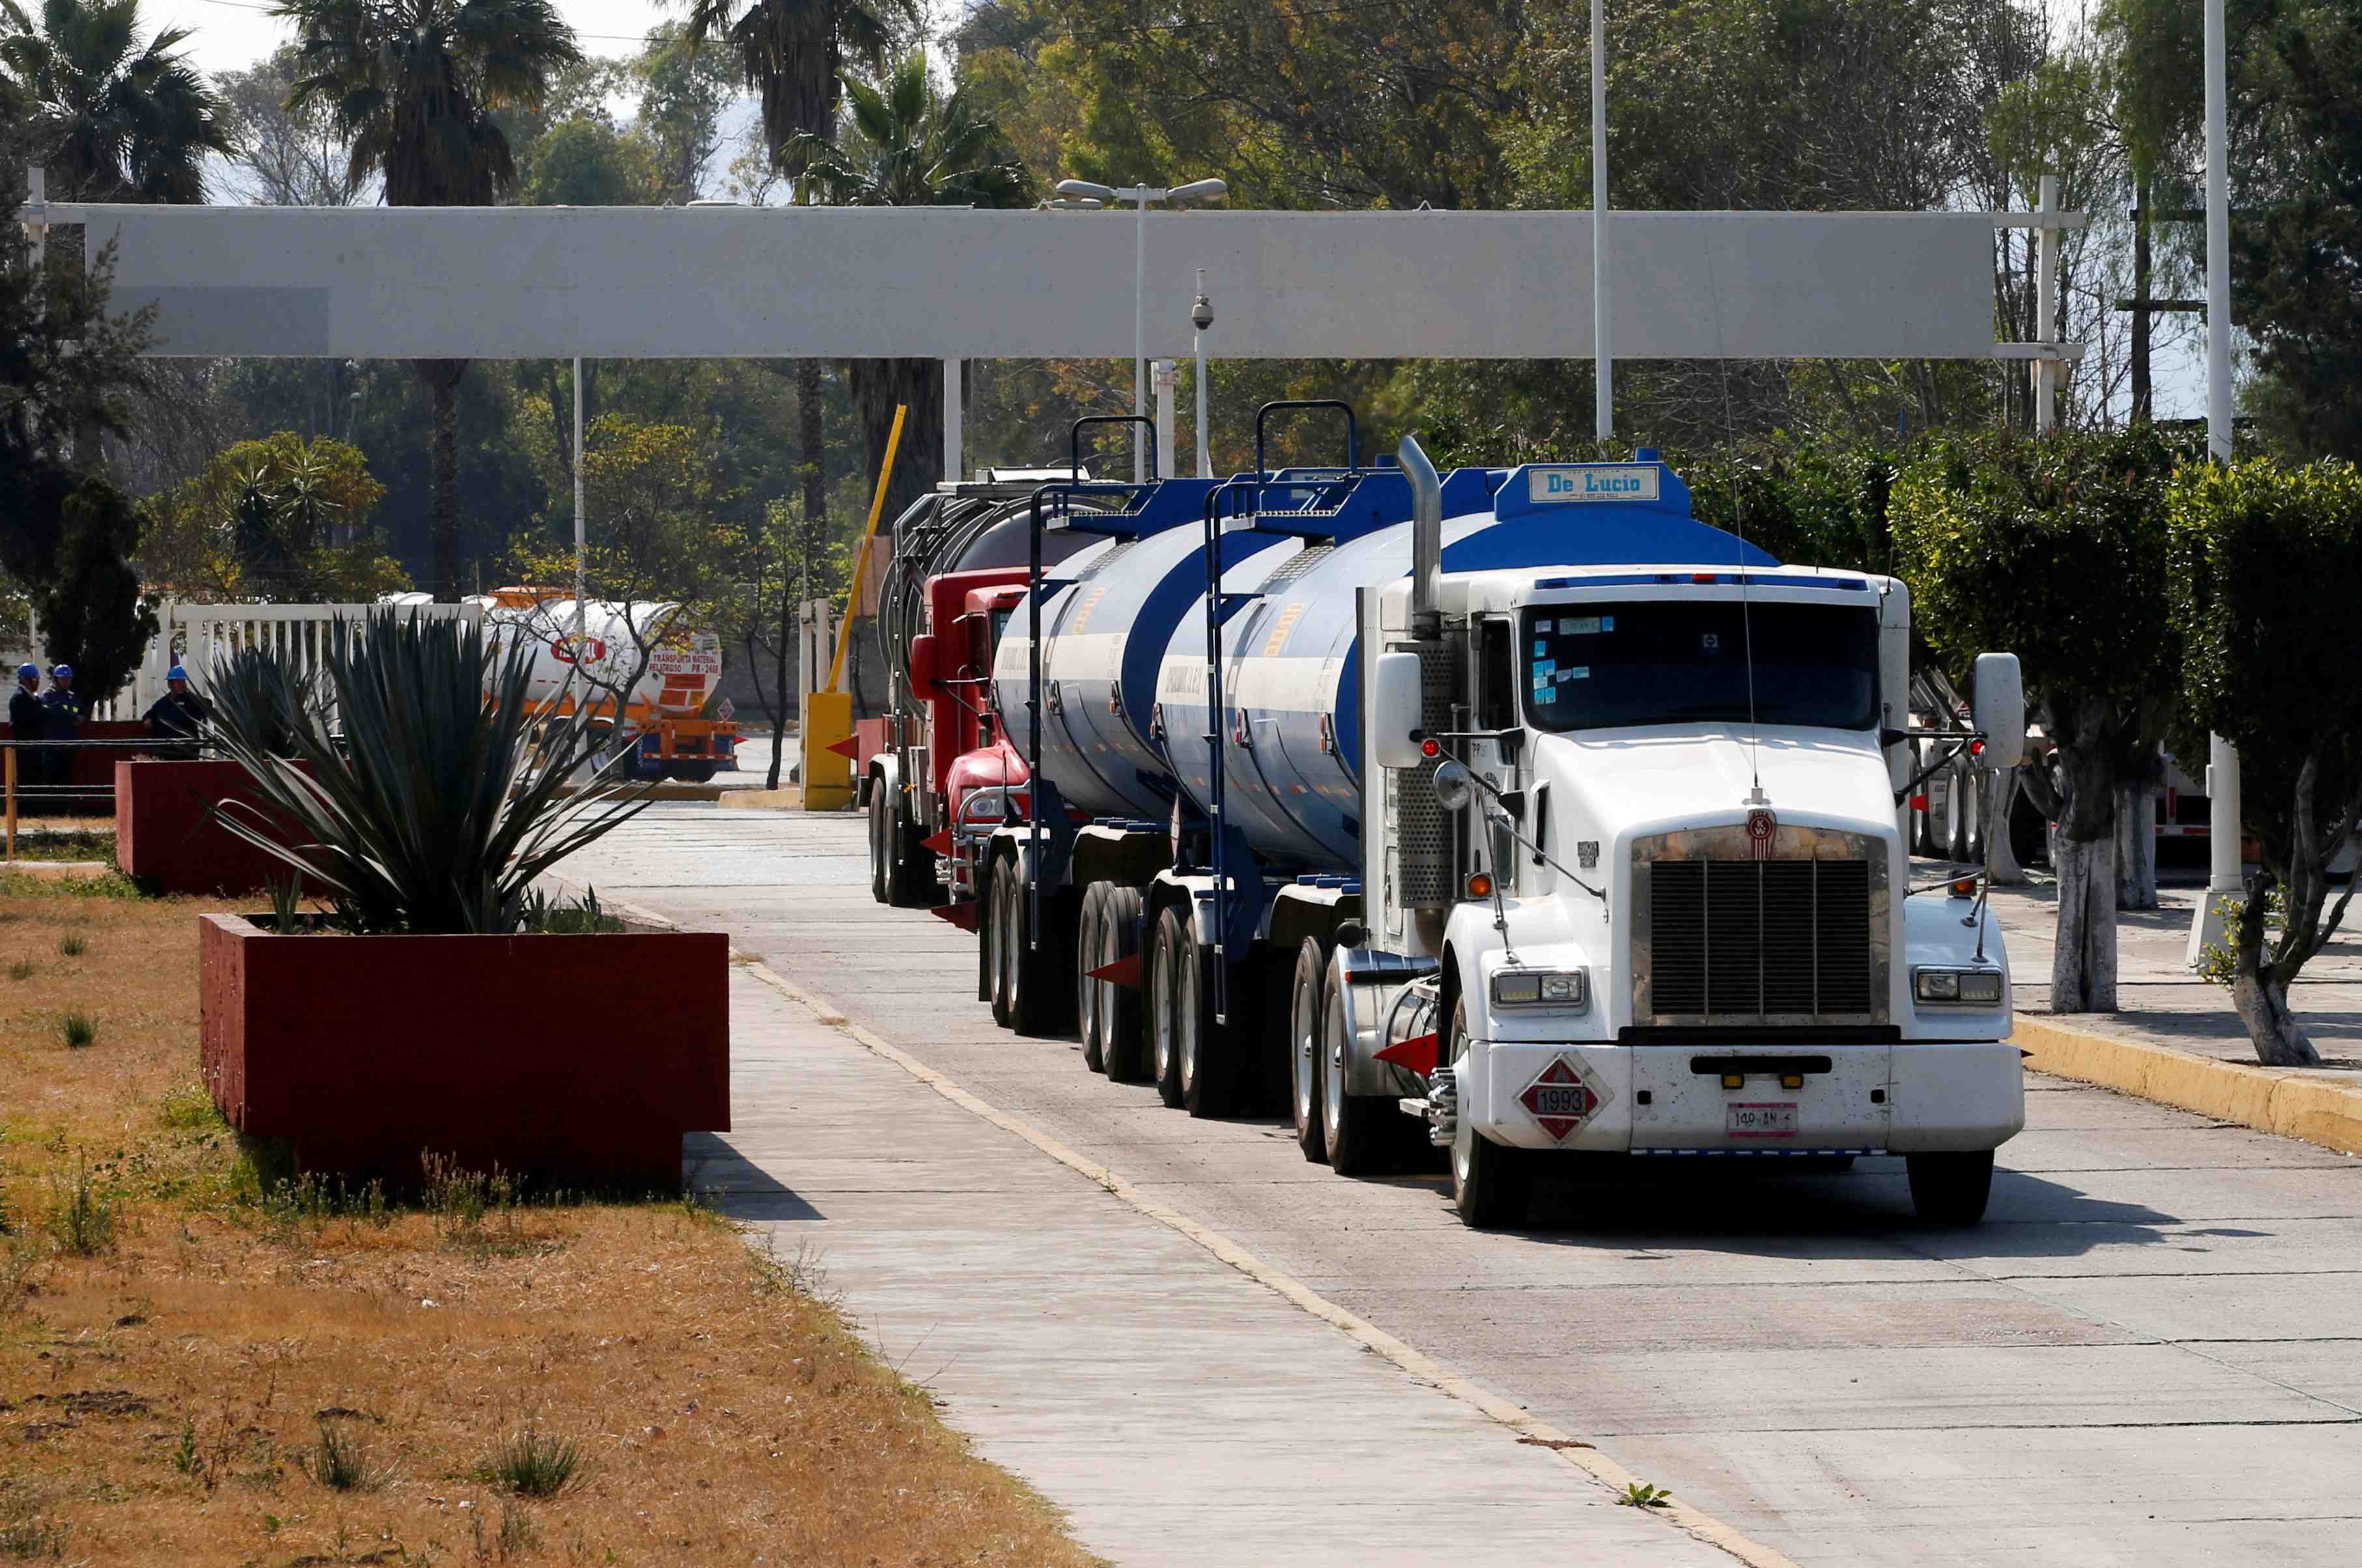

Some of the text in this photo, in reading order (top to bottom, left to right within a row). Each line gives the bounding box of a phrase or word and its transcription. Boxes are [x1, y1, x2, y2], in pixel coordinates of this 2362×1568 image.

[1547, 473, 1640, 493] De Lucio
[1540, 1090, 1583, 1112] 1993
